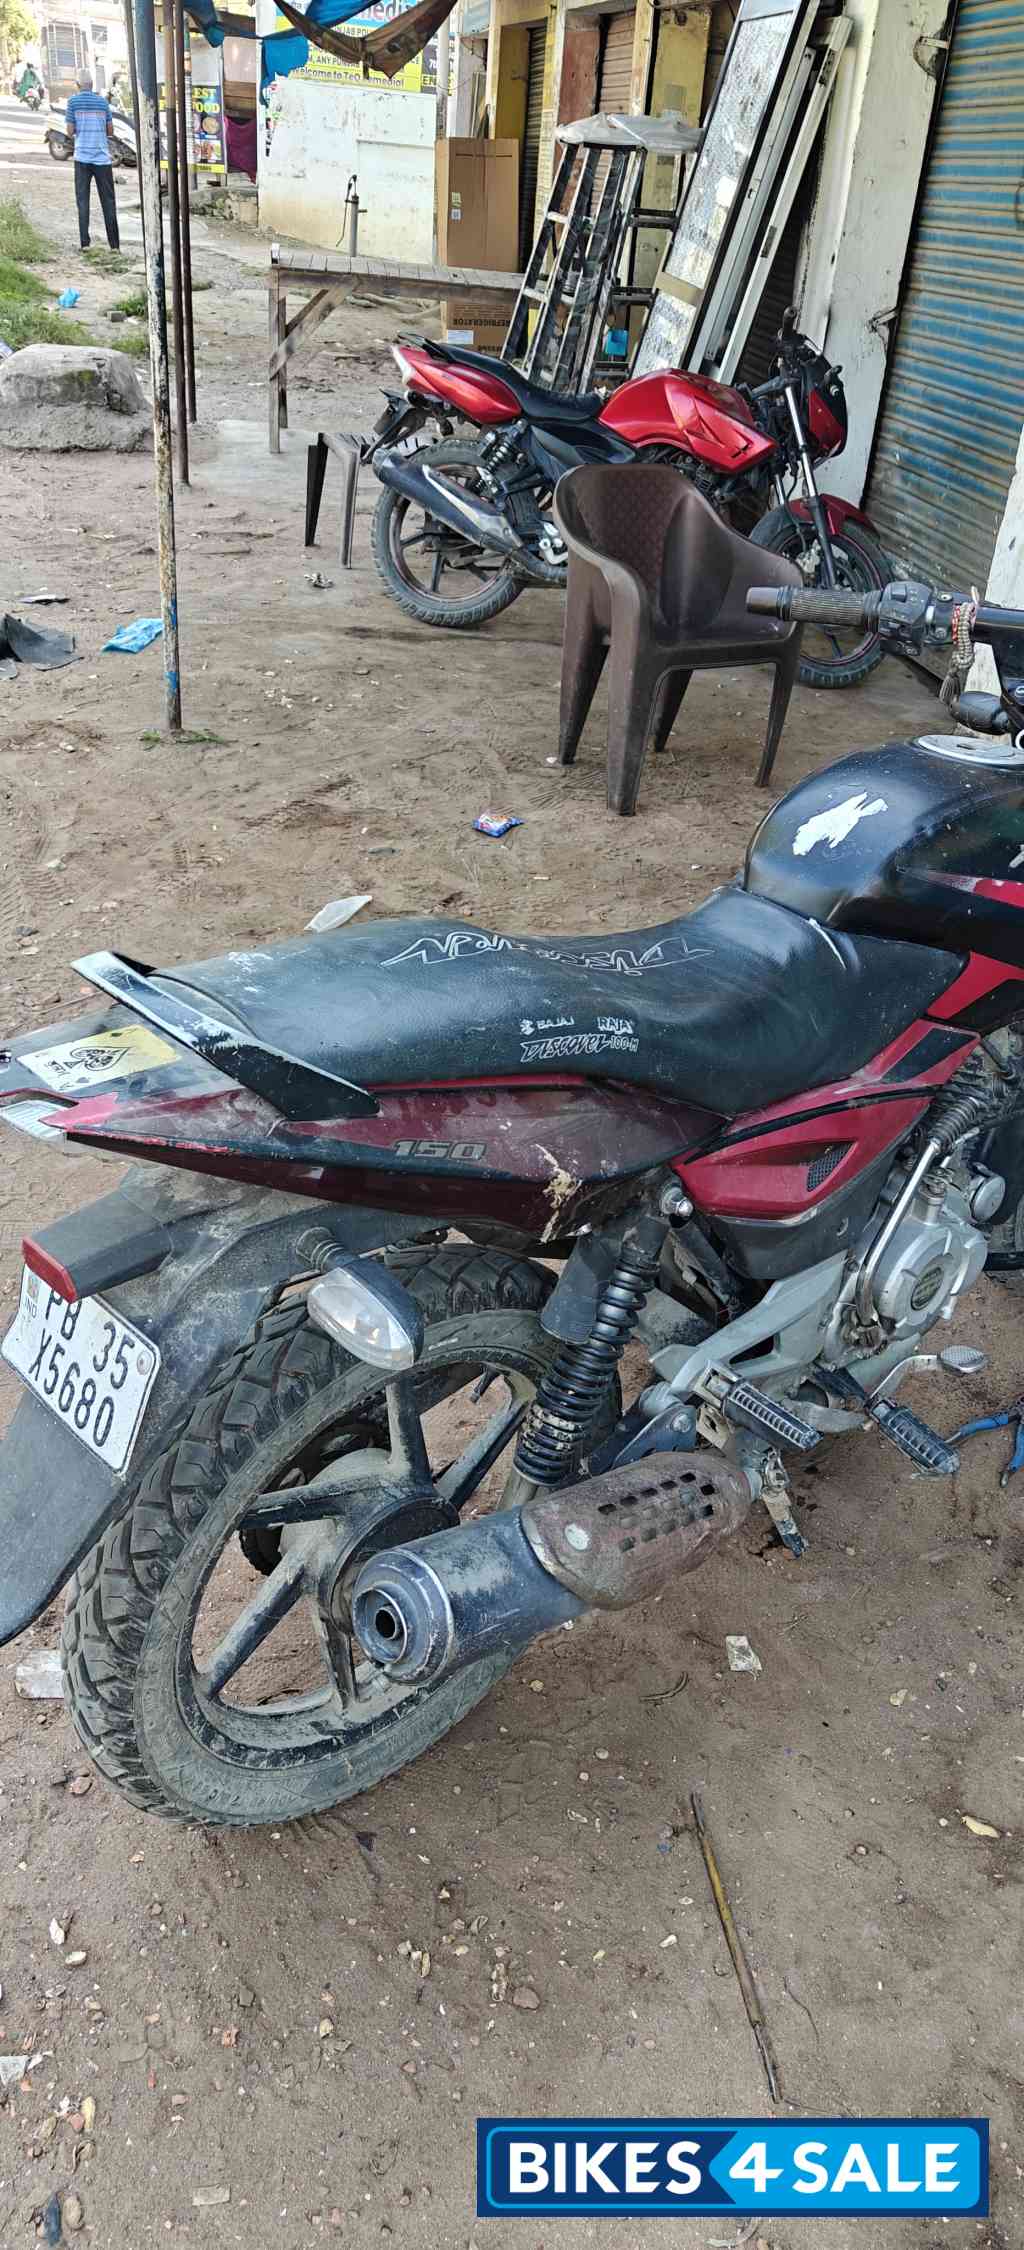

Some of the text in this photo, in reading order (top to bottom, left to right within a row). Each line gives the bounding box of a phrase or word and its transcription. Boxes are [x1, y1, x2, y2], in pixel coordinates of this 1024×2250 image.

[334, 70, 342, 79] to
[367, 77, 404, 89] emedio!
[392, 1139, 488, 1161] 150
[45, 1289, 135, 1390] PB 35
[28, 1328, 115, 1447] X5680
